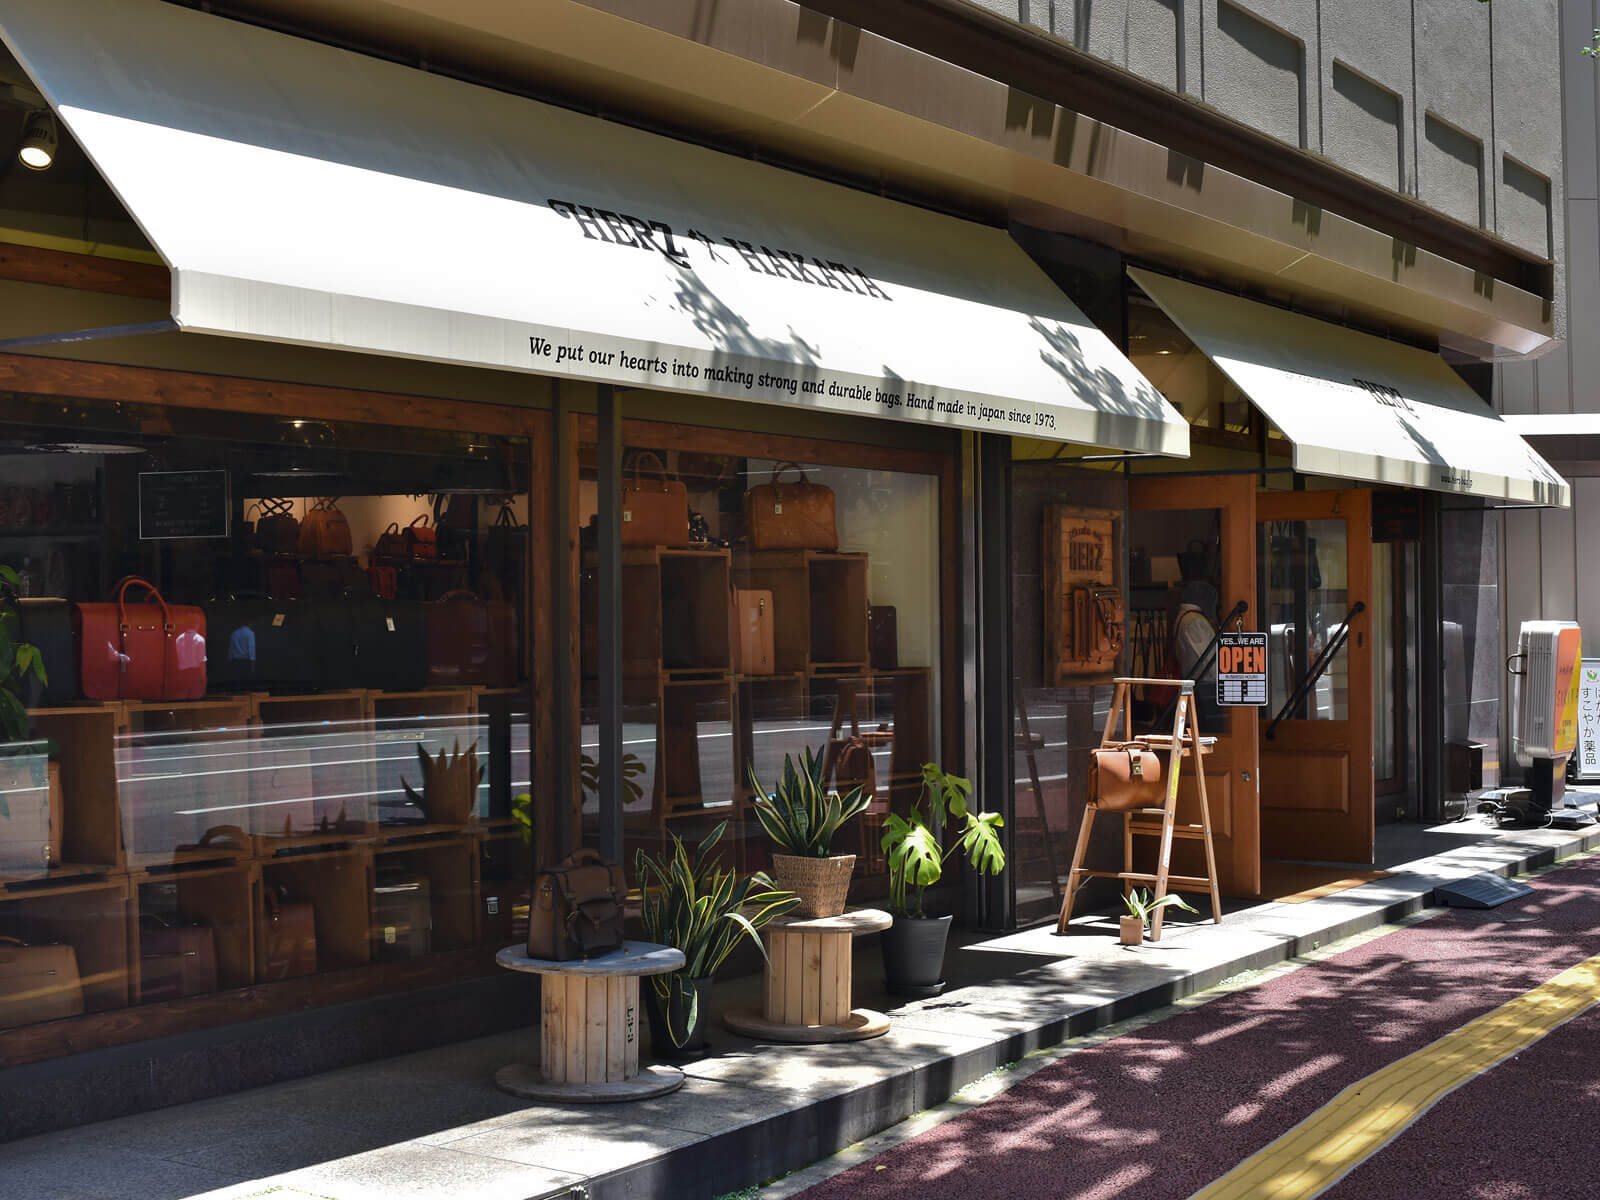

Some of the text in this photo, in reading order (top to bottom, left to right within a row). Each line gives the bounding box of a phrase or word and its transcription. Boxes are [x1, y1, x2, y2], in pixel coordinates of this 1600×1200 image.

[547, 199, 893, 302] HERZ HAKATA
[529, 337, 551, 356] We
[555, 345, 584, 363] put
[588, 350, 615, 366] our
[620, 350, 668, 374] hearts
[672, 358, 699, 378] into
[703, 366, 754, 389] making
[757, 372, 798, 395] strong
[801, 379, 825, 395] and
[828, 381, 872, 401] durable
[875, 388, 903, 409] bags.
[906, 393, 935, 410] Hand
[937, 398, 964, 415] made
[967, 401, 977, 416] in
[978, 403, 1006, 422] japan
[1008, 408, 1032, 424] since
[1219, 646, 1265, 673] OPEN
[1249, 637, 1265, 645] ARE
[1581, 687, 1596, 765] すこやか薬品
